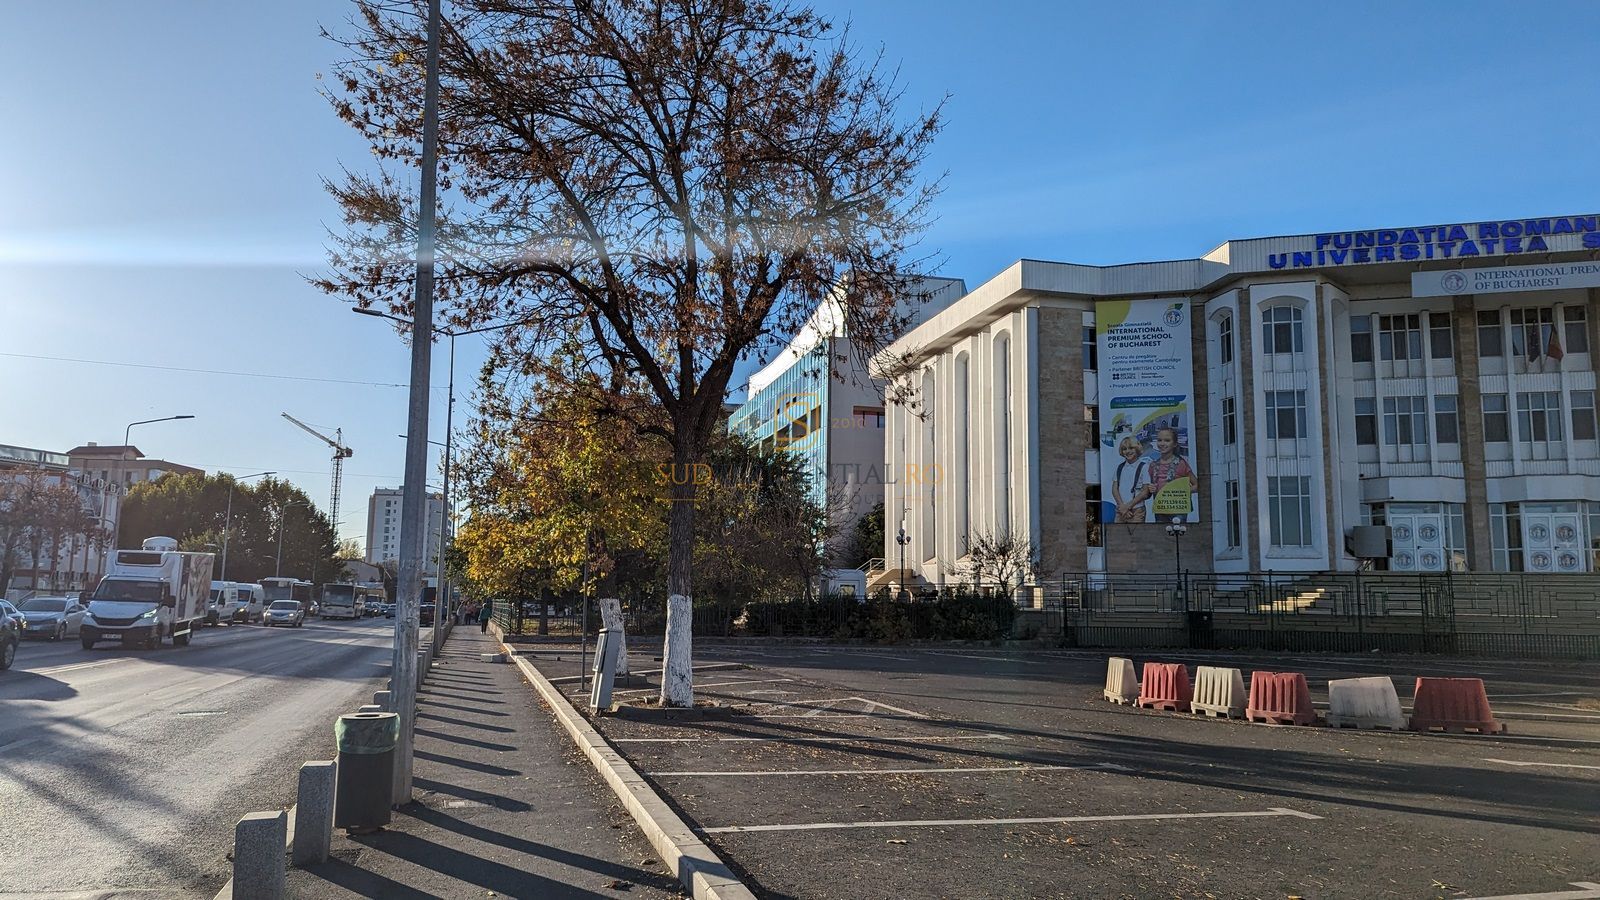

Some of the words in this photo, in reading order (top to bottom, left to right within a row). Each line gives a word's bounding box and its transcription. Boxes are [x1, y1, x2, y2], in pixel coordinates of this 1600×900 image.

[1316, 225, 1468, 250] FUNDATIA
[1479, 216, 1597, 239] ROMAN
[1268, 236, 1549, 269] UNIVERSITATEA
[1475, 266, 1568, 280] INTERNATIONAL
[1475, 281, 1491, 290] OF
[1493, 277, 1562, 290] BUCHAREST
[1119, 340, 1161, 348] BUCHAREST
